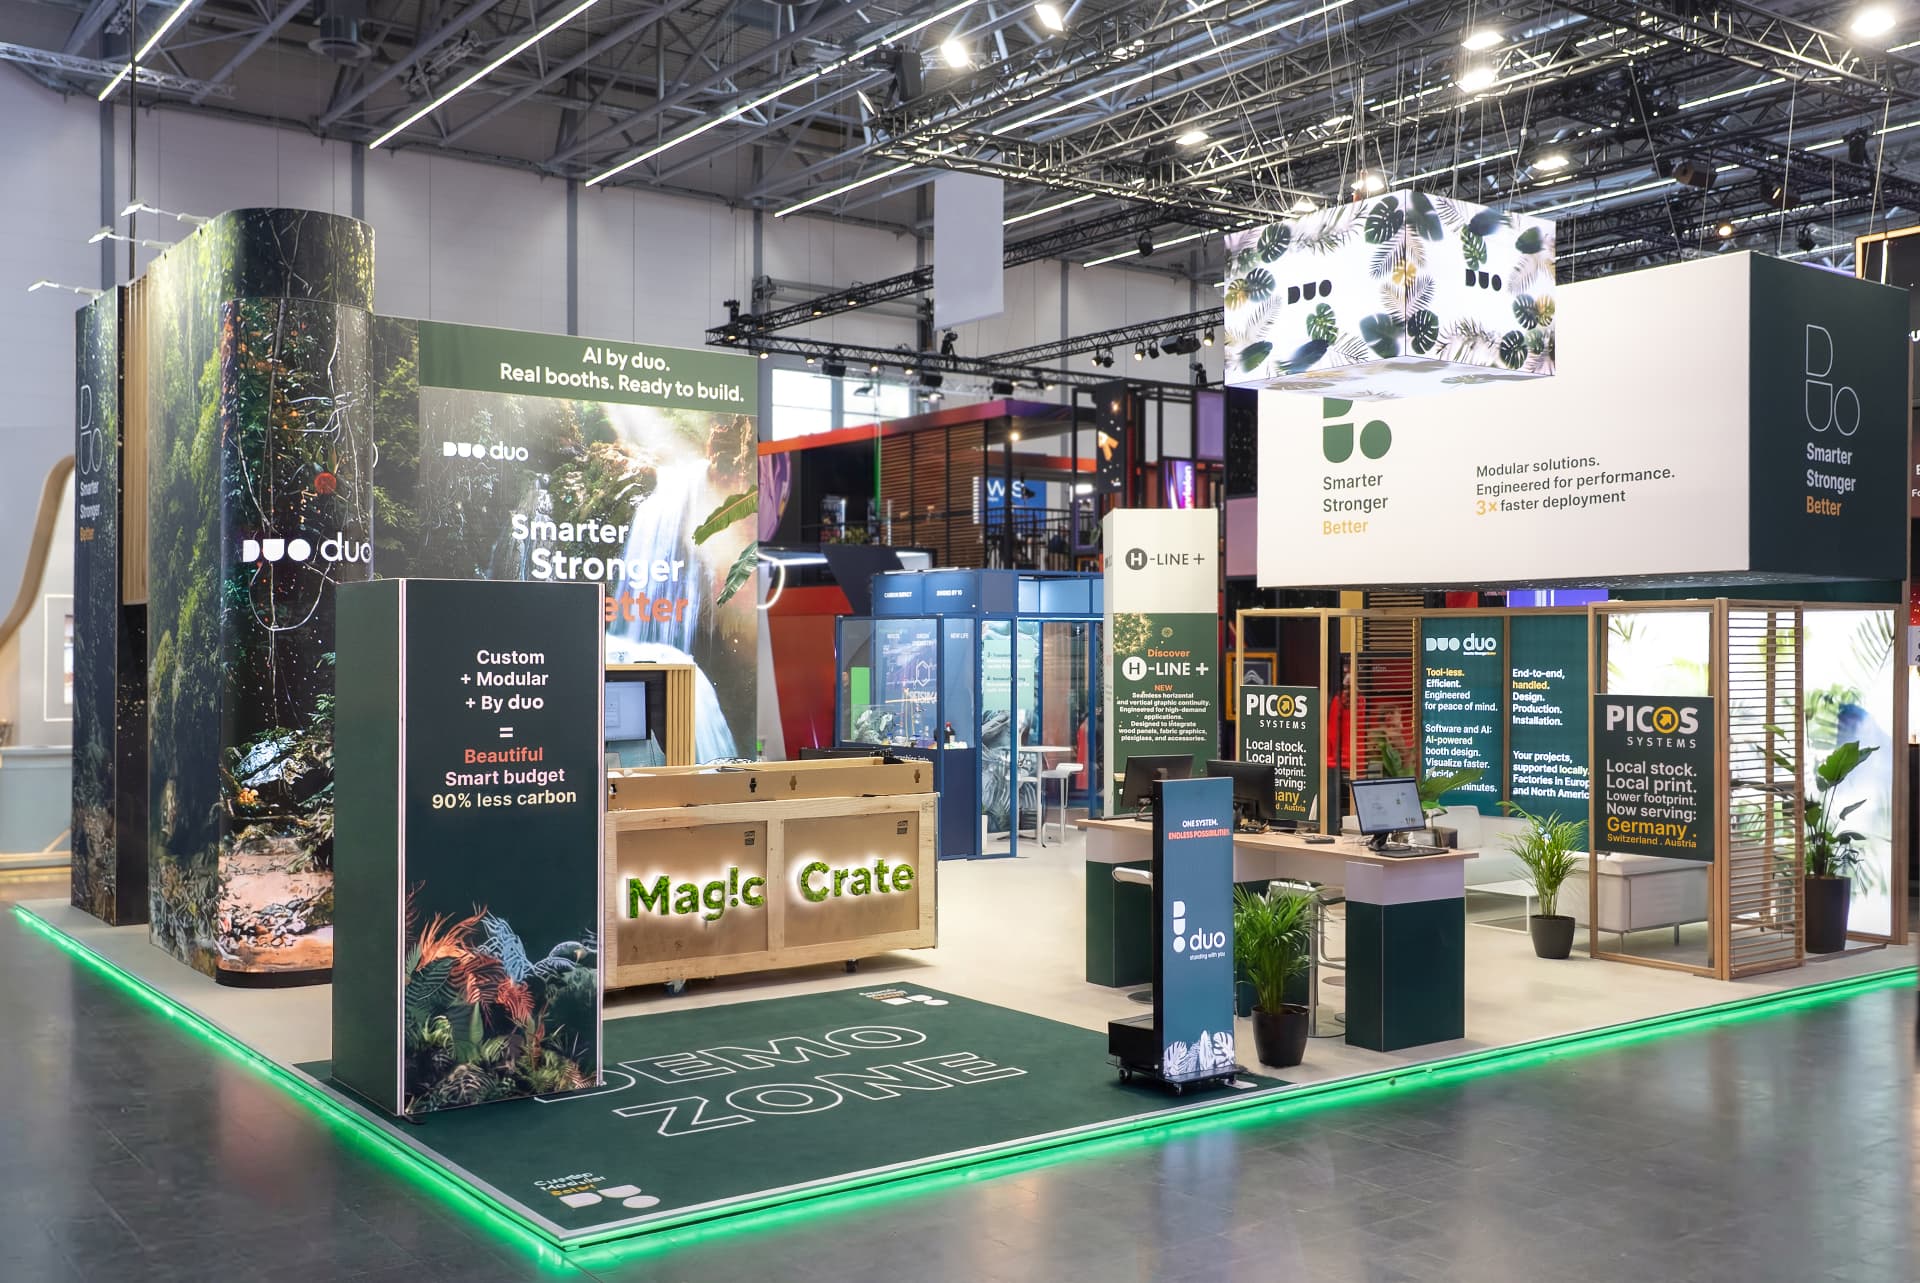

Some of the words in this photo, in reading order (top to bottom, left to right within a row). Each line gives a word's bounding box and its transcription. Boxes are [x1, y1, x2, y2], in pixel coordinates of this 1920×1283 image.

[582, 346, 602, 364] AI
[606, 349, 628, 370] by
[632, 352, 670, 372] duo.
[500, 363, 540, 382] Real
[545, 367, 614, 390] booths.
[618, 375, 672, 399] Ready
[676, 377, 693, 396] to
[697, 381, 744, 402] build.
[443, 442, 486, 460] DUO
[490, 441, 528, 461] duo
[1806, 442, 1852, 465] Smarter
[1476, 462, 1529, 478] Modular
[1533, 456, 1600, 472] solutions.
[1323, 474, 1383, 490] Smarter
[1476, 478, 1550, 497] Engineered
[1554, 476, 1573, 489] for
[1576, 468, 1675, 490] performance.
[1806, 469, 1856, 495] Stronger
[1323, 497, 1389, 514] Stronger
[1500, 498, 1539, 512] faster
[1542, 490, 1626, 508] deployment
[1806, 496, 1842, 516] Better
[511, 514, 629, 544] Smarter
[1323, 520, 1368, 536] Better
[243, 538, 311, 562] DUO
[320, 532, 372, 563] duo
[532, 548, 684, 589] Stronger
[606, 592, 688, 622] etter
[1426, 638, 1460, 651] DUO
[1463, 632, 1496, 651] duo
[476, 650, 544, 664] Custom
[1148, 648, 1190, 658] Discover
[476, 672, 548, 686] Modular
[1426, 668, 1464, 676] Tool-less.
[1512, 668, 1565, 680] End-to-end,
[1426, 678, 1461, 688] Efficient.
[1512, 680, 1550, 690] handled.
[481, 696, 503, 713] By
[508, 694, 544, 710] duo
[1425, 690, 1470, 700] Engineered
[1512, 692, 1545, 703] Design.
[1246, 694, 1308, 717] PICOS
[1425, 702, 1437, 710] for
[1438, 703, 1463, 712] peace
[1465, 702, 1473, 710] of
[1475, 702, 1498, 711] mind.
[1512, 704, 1562, 714] Production.
[1260, 720, 1306, 730] SYSTEMS
[1512, 716, 1563, 726] Installation.
[1606, 705, 1698, 734] PICOS
[1425, 724, 1461, 733] Software
[1464, 725, 1479, 733] and
[1481, 725, 1492, 734] AI:
[1246, 738, 1272, 750] Local
[1275, 740, 1306, 753] stock.
[1425, 736, 1472, 745] AI-powered
[1627, 736, 1696, 748] SYSTEMS
[464, 747, 543, 764] Beautiful
[1246, 750, 1274, 764] Local
[1277, 753, 1306, 767] print.
[1426, 747, 1449, 755] booth
[1451, 747, 1481, 758] design.
[1512, 751, 1533, 760] Your
[1534, 752, 1573, 764] projects,
[1425, 757, 1462, 767] Visualize
[1464, 759, 1490, 768] faster.
[1512, 764, 1557, 774] supported
[1559, 765, 1590, 776] locally.
[1606, 759, 1646, 774] Local
[1650, 763, 1697, 776] stock.
[445, 770, 499, 786] Smart
[504, 769, 565, 786] budget
[1274, 778, 1306, 791] erving:
[1512, 774, 1553, 785] Factories
[1555, 776, 1563, 786] in
[1565, 777, 1589, 791] Europ
[1606, 774, 1648, 790] Local
[1654, 778, 1697, 794] print.
[1461, 783, 1497, 792] minutes.
[1512, 787, 1529, 795] and
[1531, 788, 1556, 797] North
[1558, 789, 1589, 799] Americ
[432, 793, 471, 809] 90%
[478, 793, 512, 807] less
[517, 790, 576, 805] carbon
[1606, 790, 1641, 802] Lower
[1644, 793, 1697, 806] footprint.
[1284, 804, 1306, 812] Austria
[1606, 802, 1637, 815] Now
[1641, 806, 1697, 823] serving:
[1607, 817, 1687, 840] Germany
[1608, 834, 1657, 845] Switzerland
[1665, 838, 1696, 848] Austria
[800, 858, 914, 903] Crate
[1190, 928, 1226, 951] duo
[612, 1052, 1028, 1136] ZONE
